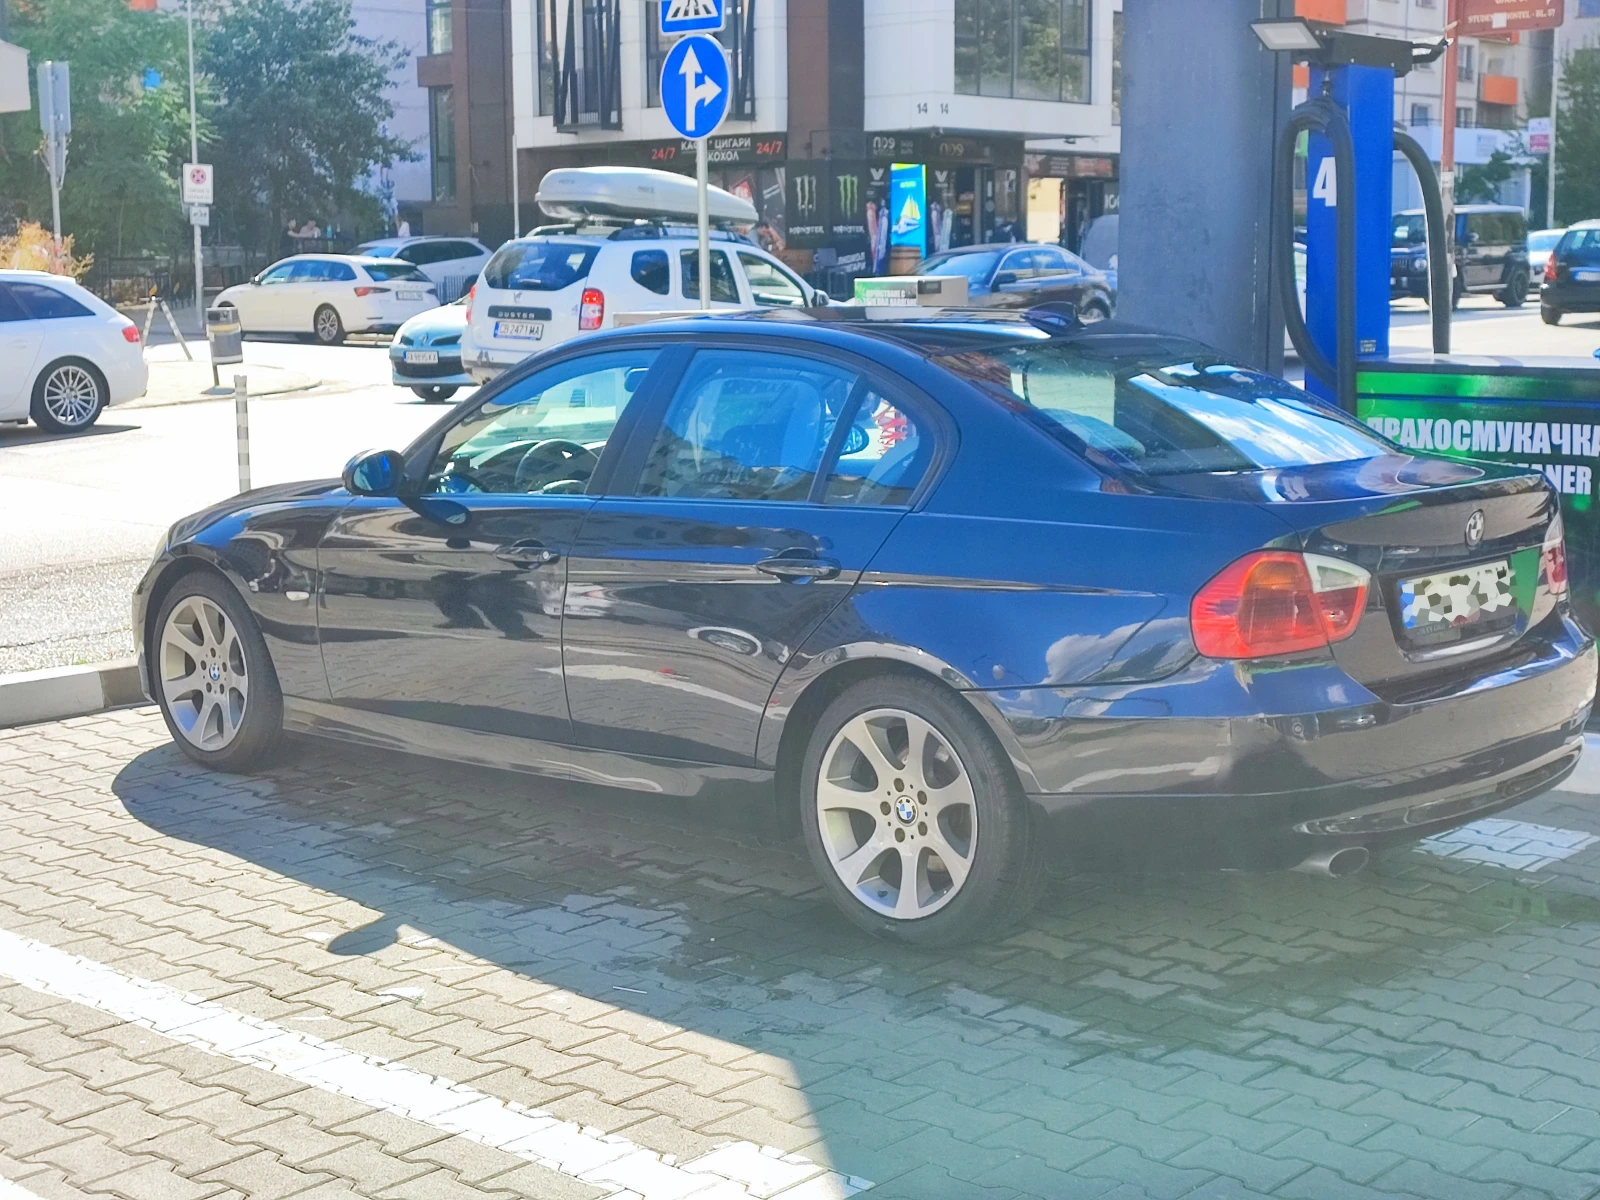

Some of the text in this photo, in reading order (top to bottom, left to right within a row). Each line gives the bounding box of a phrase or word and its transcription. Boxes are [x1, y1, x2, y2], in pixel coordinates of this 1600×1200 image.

[916, 102, 928, 114] 14
[940, 102, 949, 114] 14
[714, 138, 752, 149] ЦИГАРИ
[756, 141, 783, 154] 24/7
[651, 147, 676, 160] 24/7
[708, 151, 739, 162] КОХОЛ
[1313, 156, 1337, 207] 4
